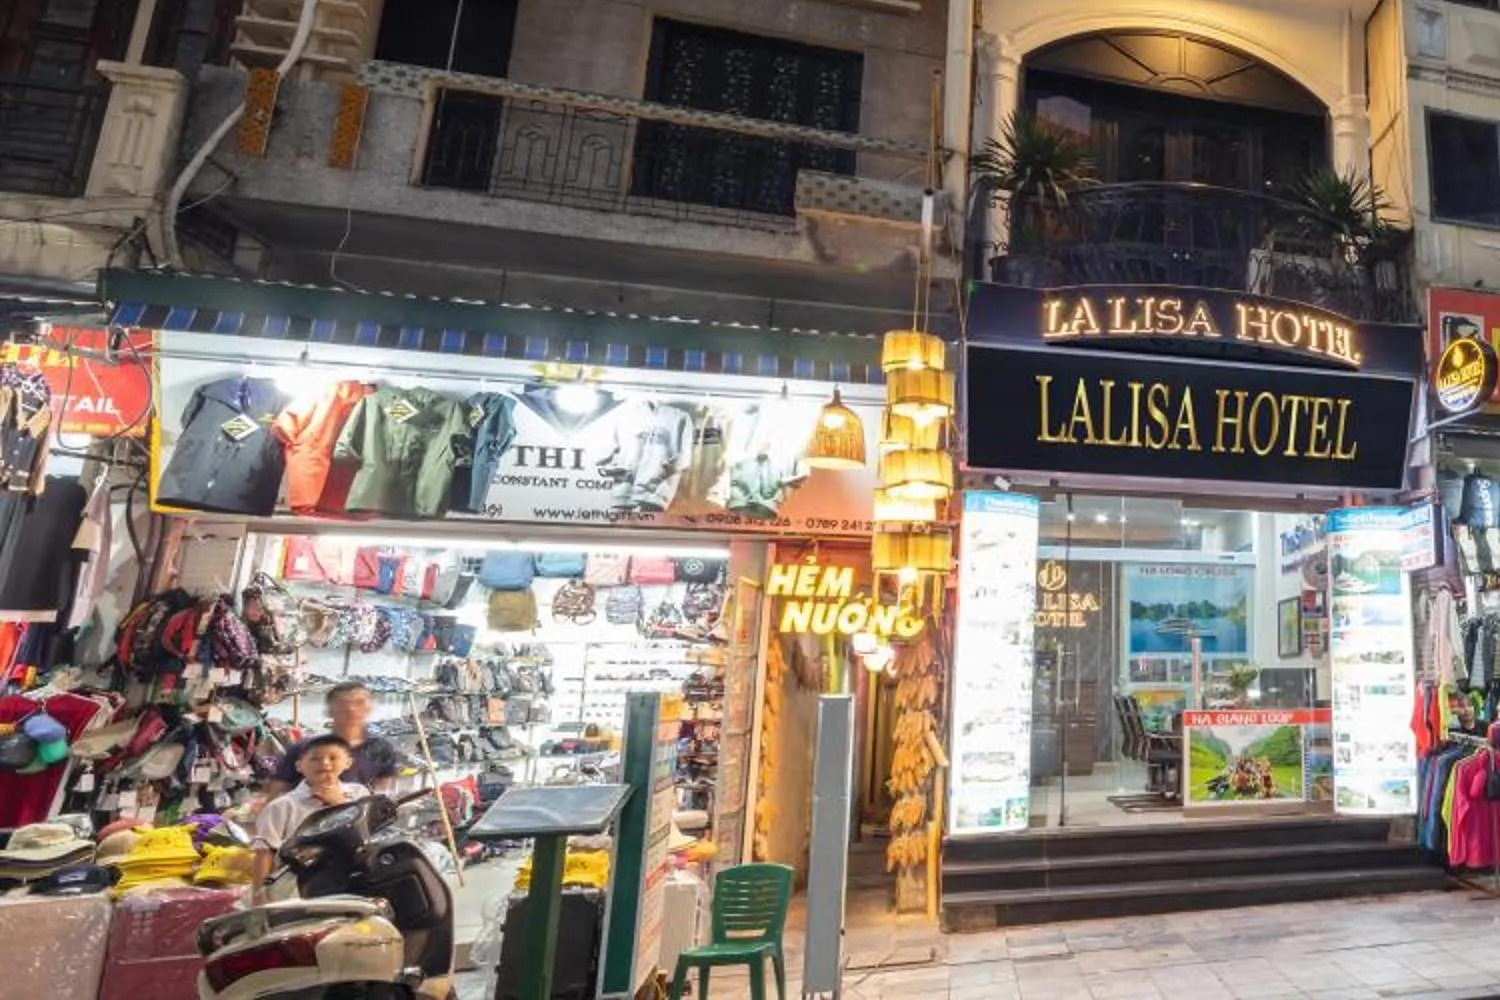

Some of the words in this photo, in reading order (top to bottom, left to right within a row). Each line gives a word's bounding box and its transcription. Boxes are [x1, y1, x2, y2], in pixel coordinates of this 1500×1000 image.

[1043, 298, 1100, 337] LA
[1108, 297, 1220, 337] LISA
[1234, 302, 1361, 366] HOTEL
[1036, 375, 1201, 451] LALISA
[1211, 388, 1357, 460] HOTEL
[510, 445, 585, 470] THI
